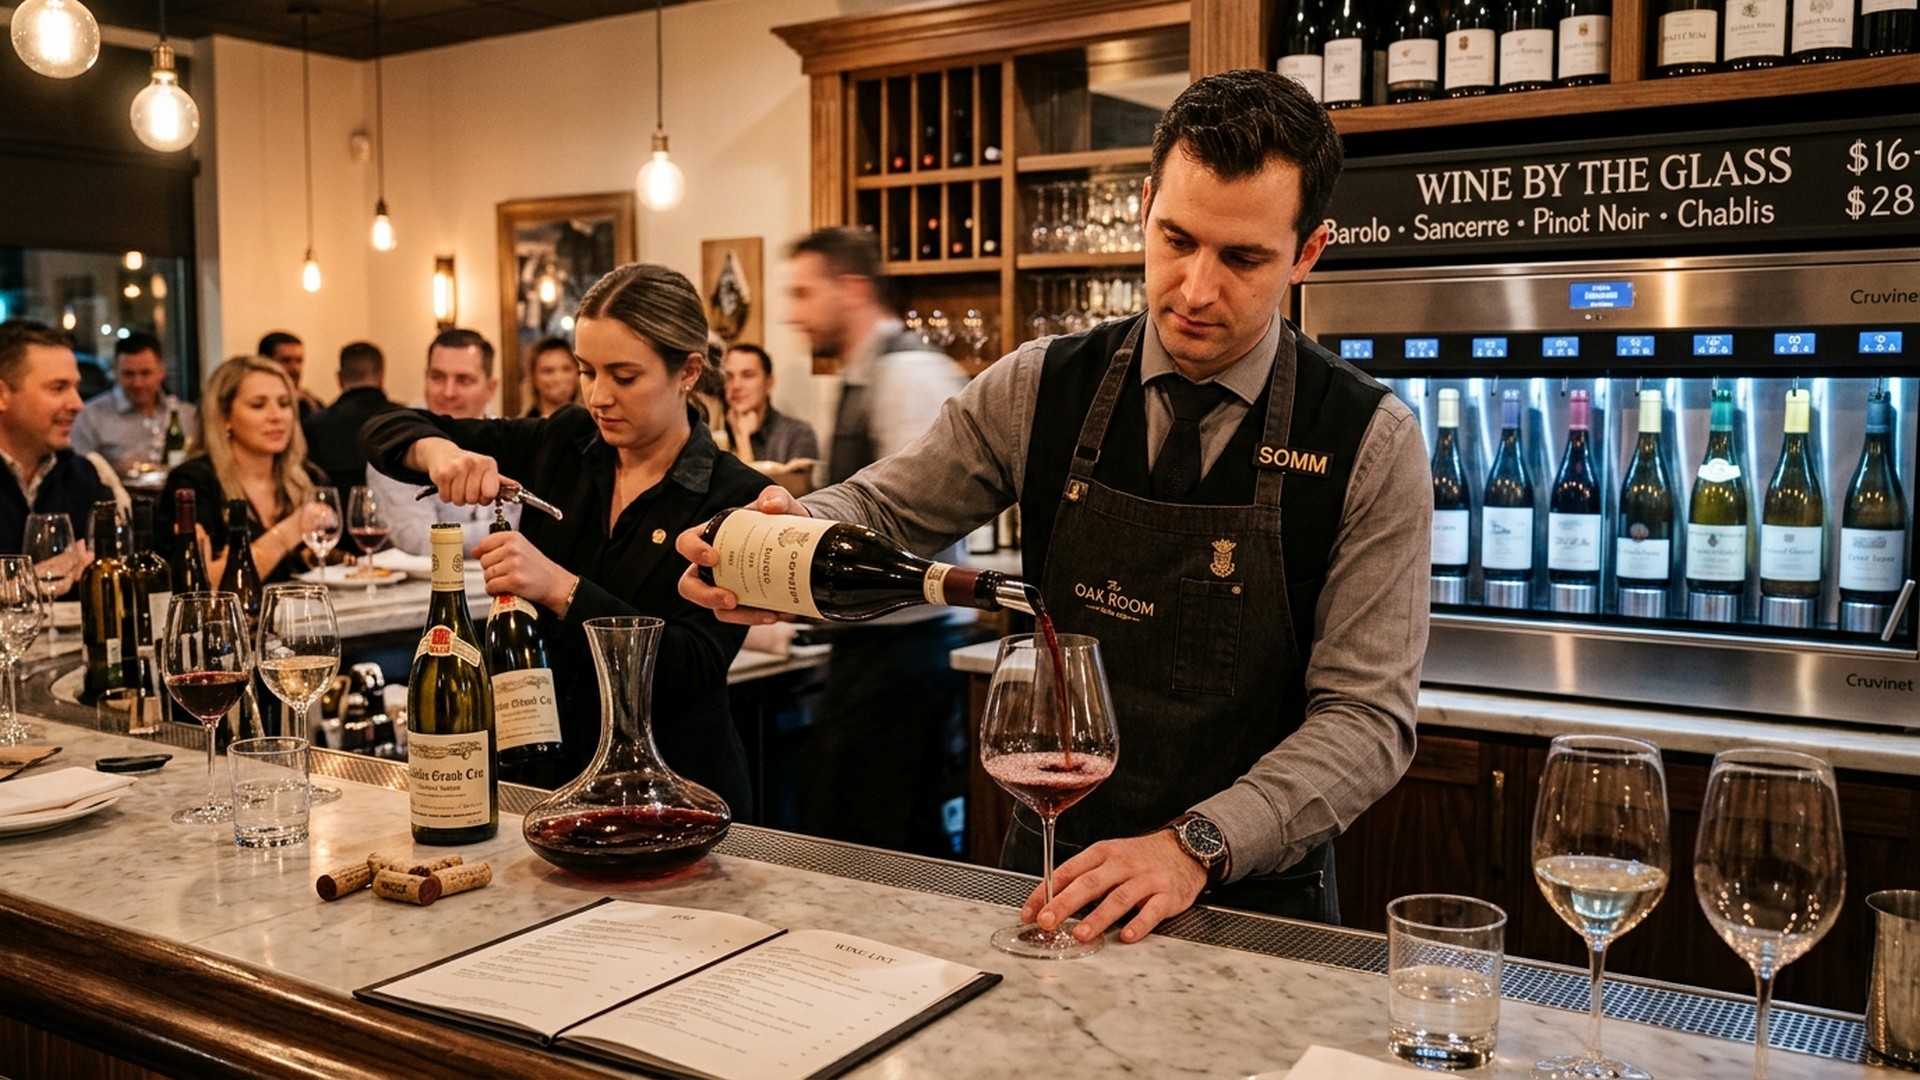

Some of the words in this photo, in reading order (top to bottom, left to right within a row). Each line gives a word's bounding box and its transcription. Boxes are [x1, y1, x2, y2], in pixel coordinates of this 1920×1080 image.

[1416, 167, 1513, 205] WINE
[1523, 162, 1571, 200] BY
[1578, 157, 1650, 195] THE
[1659, 146, 1793, 190] GLASS
[1845, 184, 1915, 220] $28
[1324, 217, 1391, 246] Barolo
[1413, 213, 1510, 241] Sancerre
[1533, 206, 1591, 235] Pinot
[1599, 203, 1650, 232] Noir
[1677, 195, 1775, 228] Chablis
[1850, 288, 1919, 305] Cruvine
[1258, 446, 1328, 475] SOMM
[1074, 583, 1105, 604] OAK
[1108, 592, 1155, 617] ROOM
[1846, 673, 1915, 691] Cruvinet
